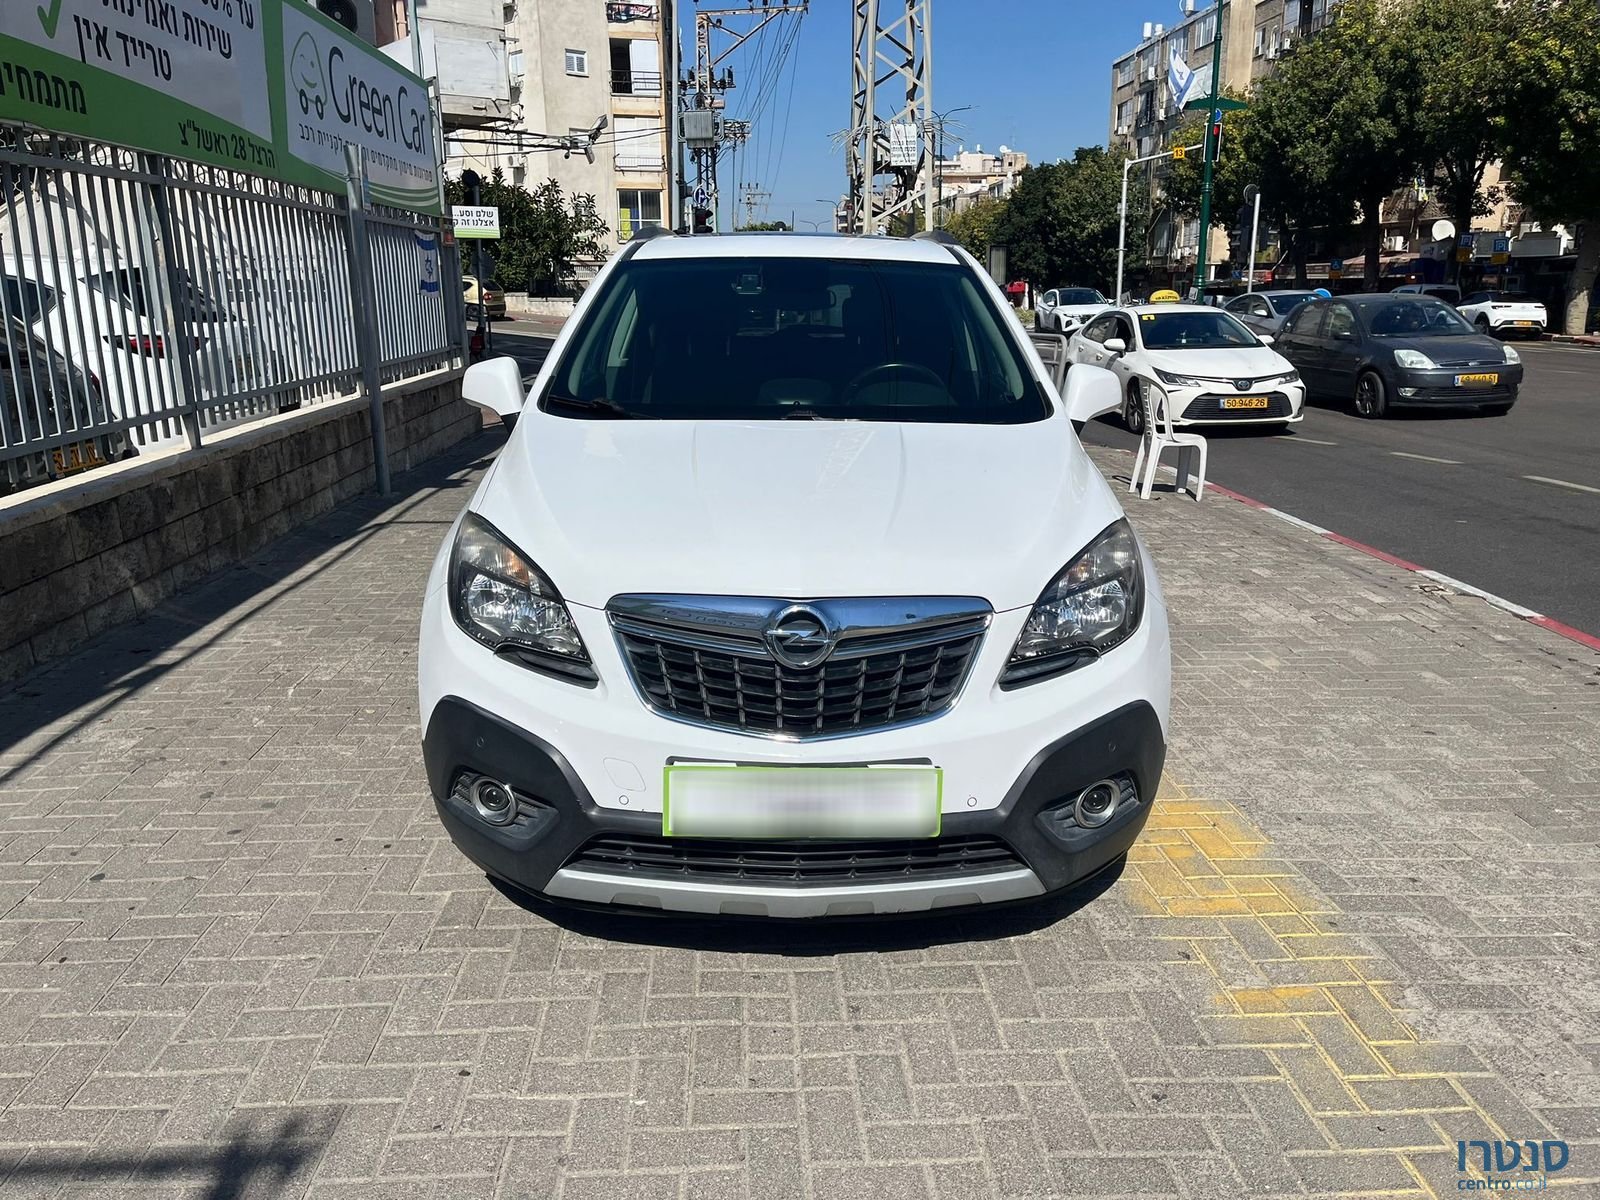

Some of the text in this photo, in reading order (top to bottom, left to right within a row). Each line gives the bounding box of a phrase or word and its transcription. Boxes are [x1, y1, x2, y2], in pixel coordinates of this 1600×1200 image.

[237, 0, 254, 29] עד
[73, 14, 172, 81] טרייד אין
[182, 11, 232, 59] שירות
[0, 62, 87, 115] מתמחי
[328, 46, 426, 155] Green Car
[231, 133, 247, 160] 28
[298, 123, 315, 142] רכב
[317, 133, 343, 155] לקניית
[248, 137, 275, 169] הרצל
[1175, 149, 1183, 157] 13
[472, 218, 494, 226] אצלנו
[476, 209, 494, 217] שלם
